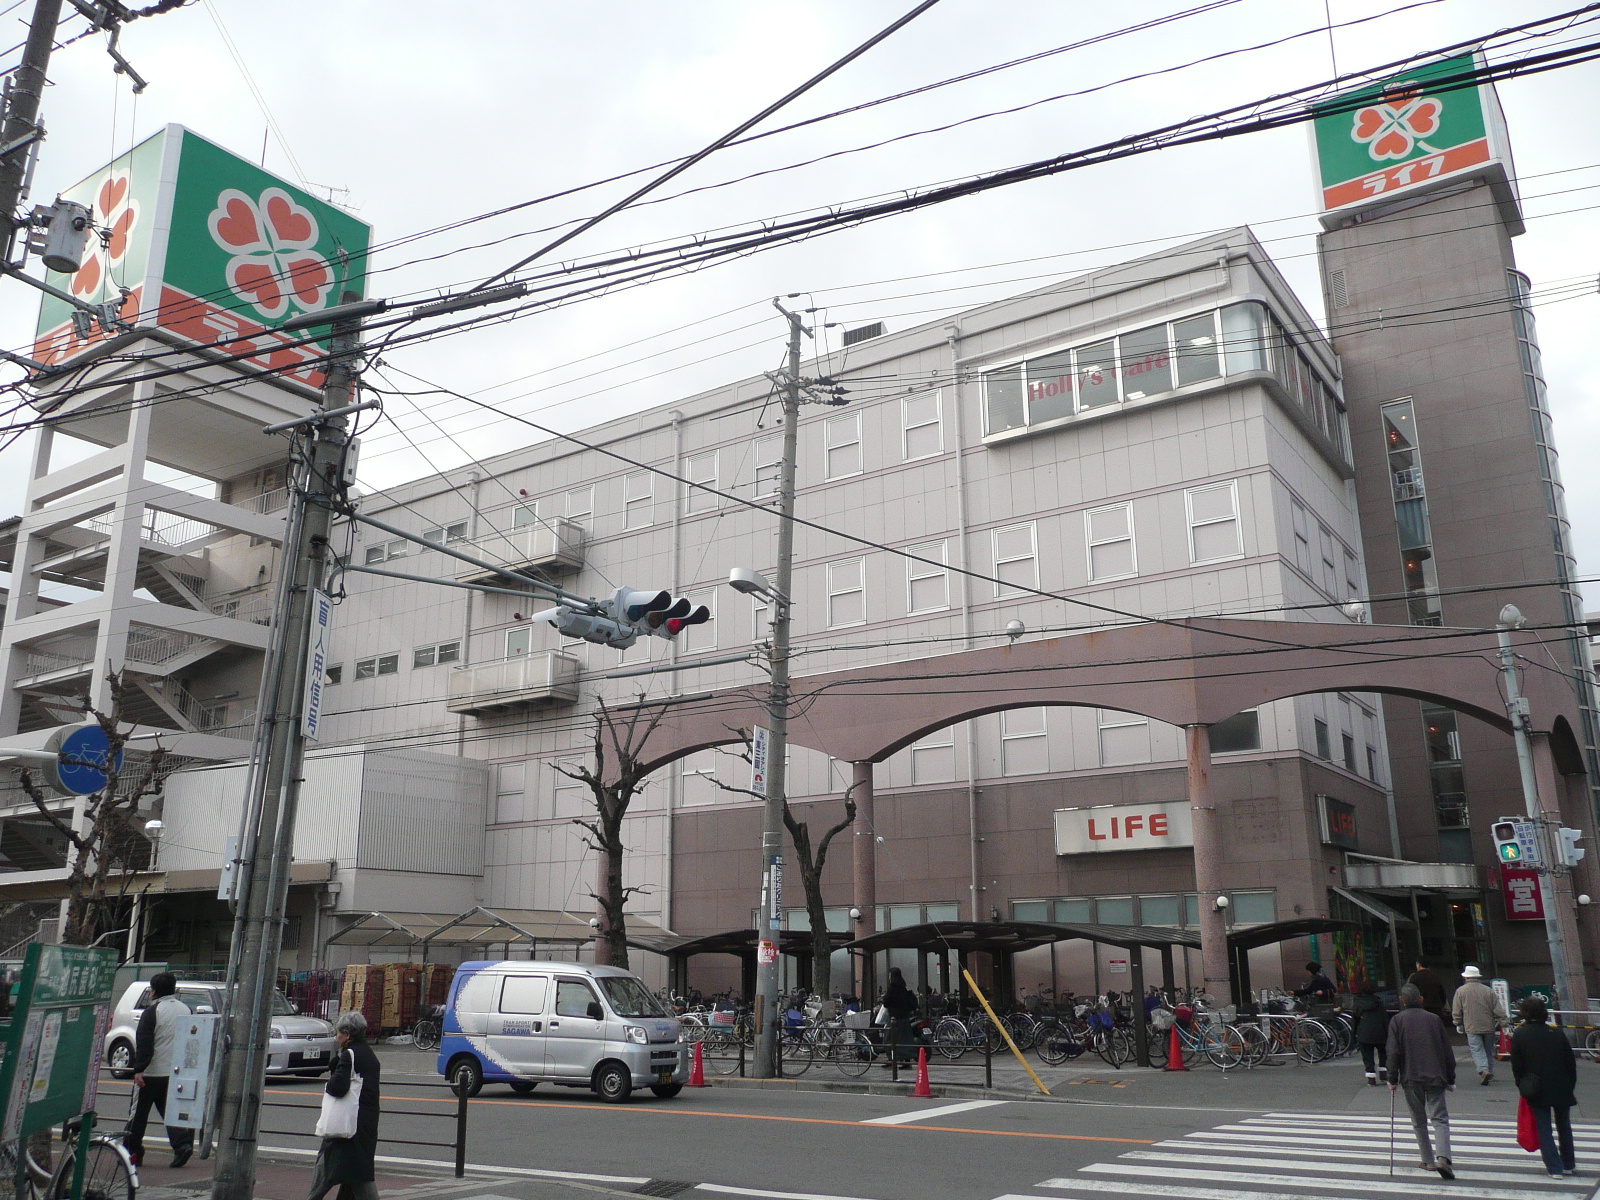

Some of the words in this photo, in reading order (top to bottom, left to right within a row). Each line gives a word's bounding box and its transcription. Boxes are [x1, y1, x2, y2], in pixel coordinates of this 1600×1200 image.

[1362, 155, 1445, 195] ライフ
[307, 599, 330, 737] 盲人用信号
[1088, 813, 1168, 840] LIFE
[1330, 809, 1356, 838] LIFE
[502, 1027, 531, 1035] SAGAWA
